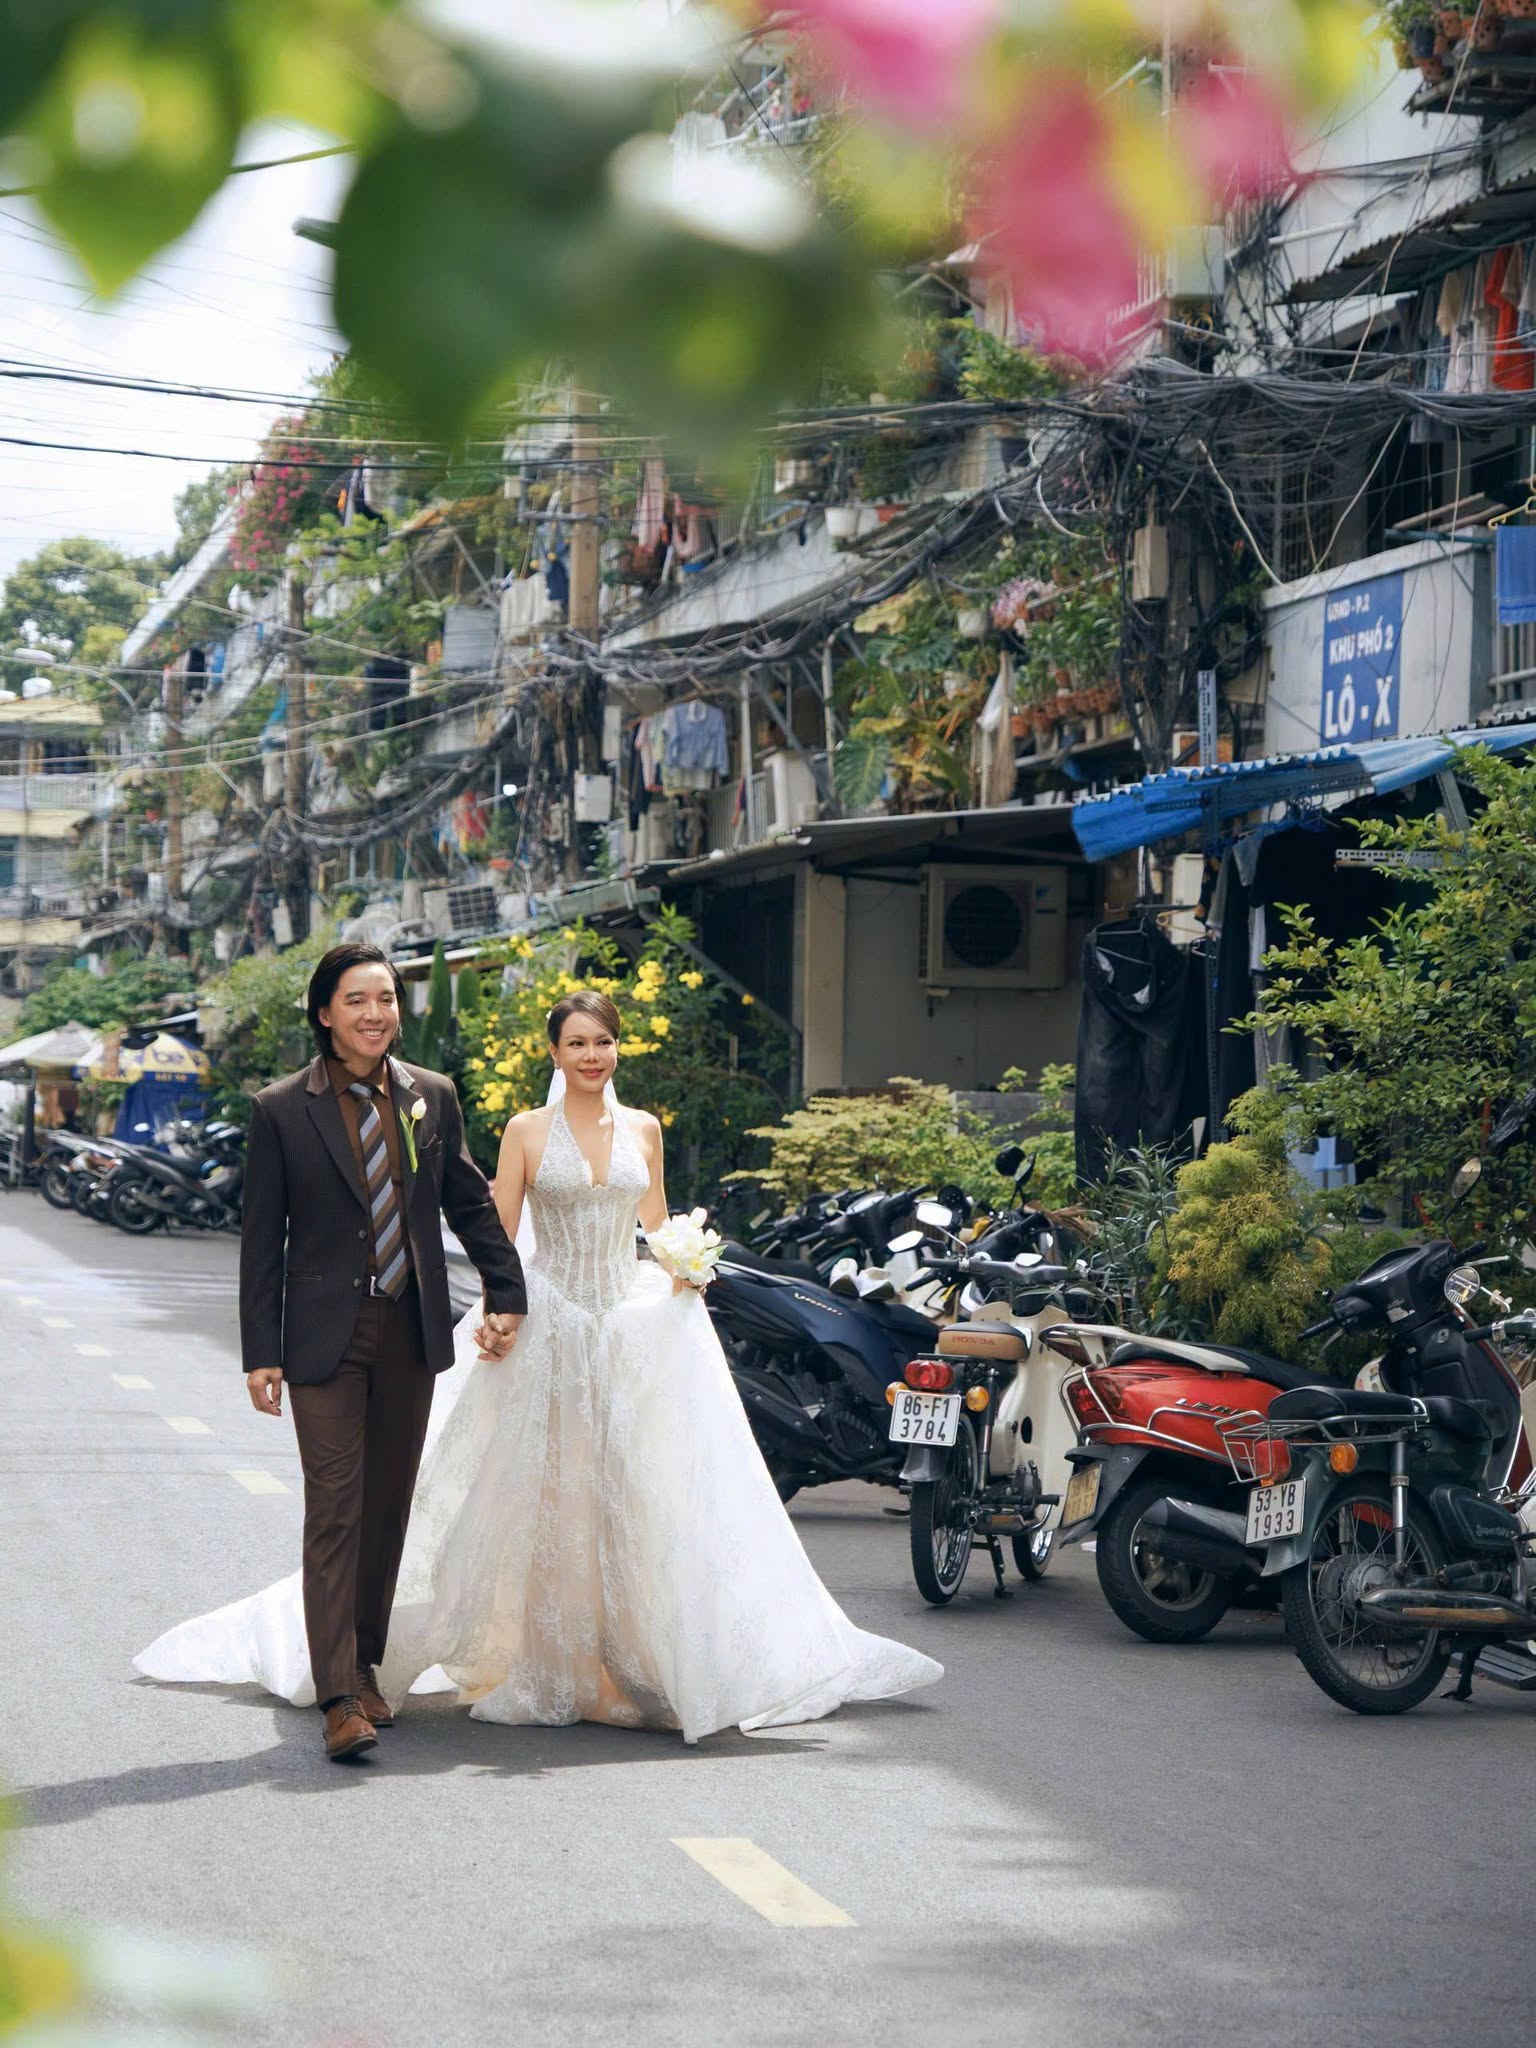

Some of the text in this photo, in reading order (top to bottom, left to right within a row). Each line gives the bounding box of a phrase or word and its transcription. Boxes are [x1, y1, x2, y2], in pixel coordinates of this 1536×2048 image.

[1329, 634, 1356, 665] KHU
[1384, 624, 1394, 650] 2
[1325, 673, 1356, 739] LÔ
[1374, 675, 1393, 728] X
[952, 1335, 995, 1346] HONDA
[903, 1395, 950, 1418] 86-F1
[900, 1418, 946, 1441] 3784
[1255, 1484, 1296, 1513] 53-YB
[1254, 1509, 1294, 1539] 1933
